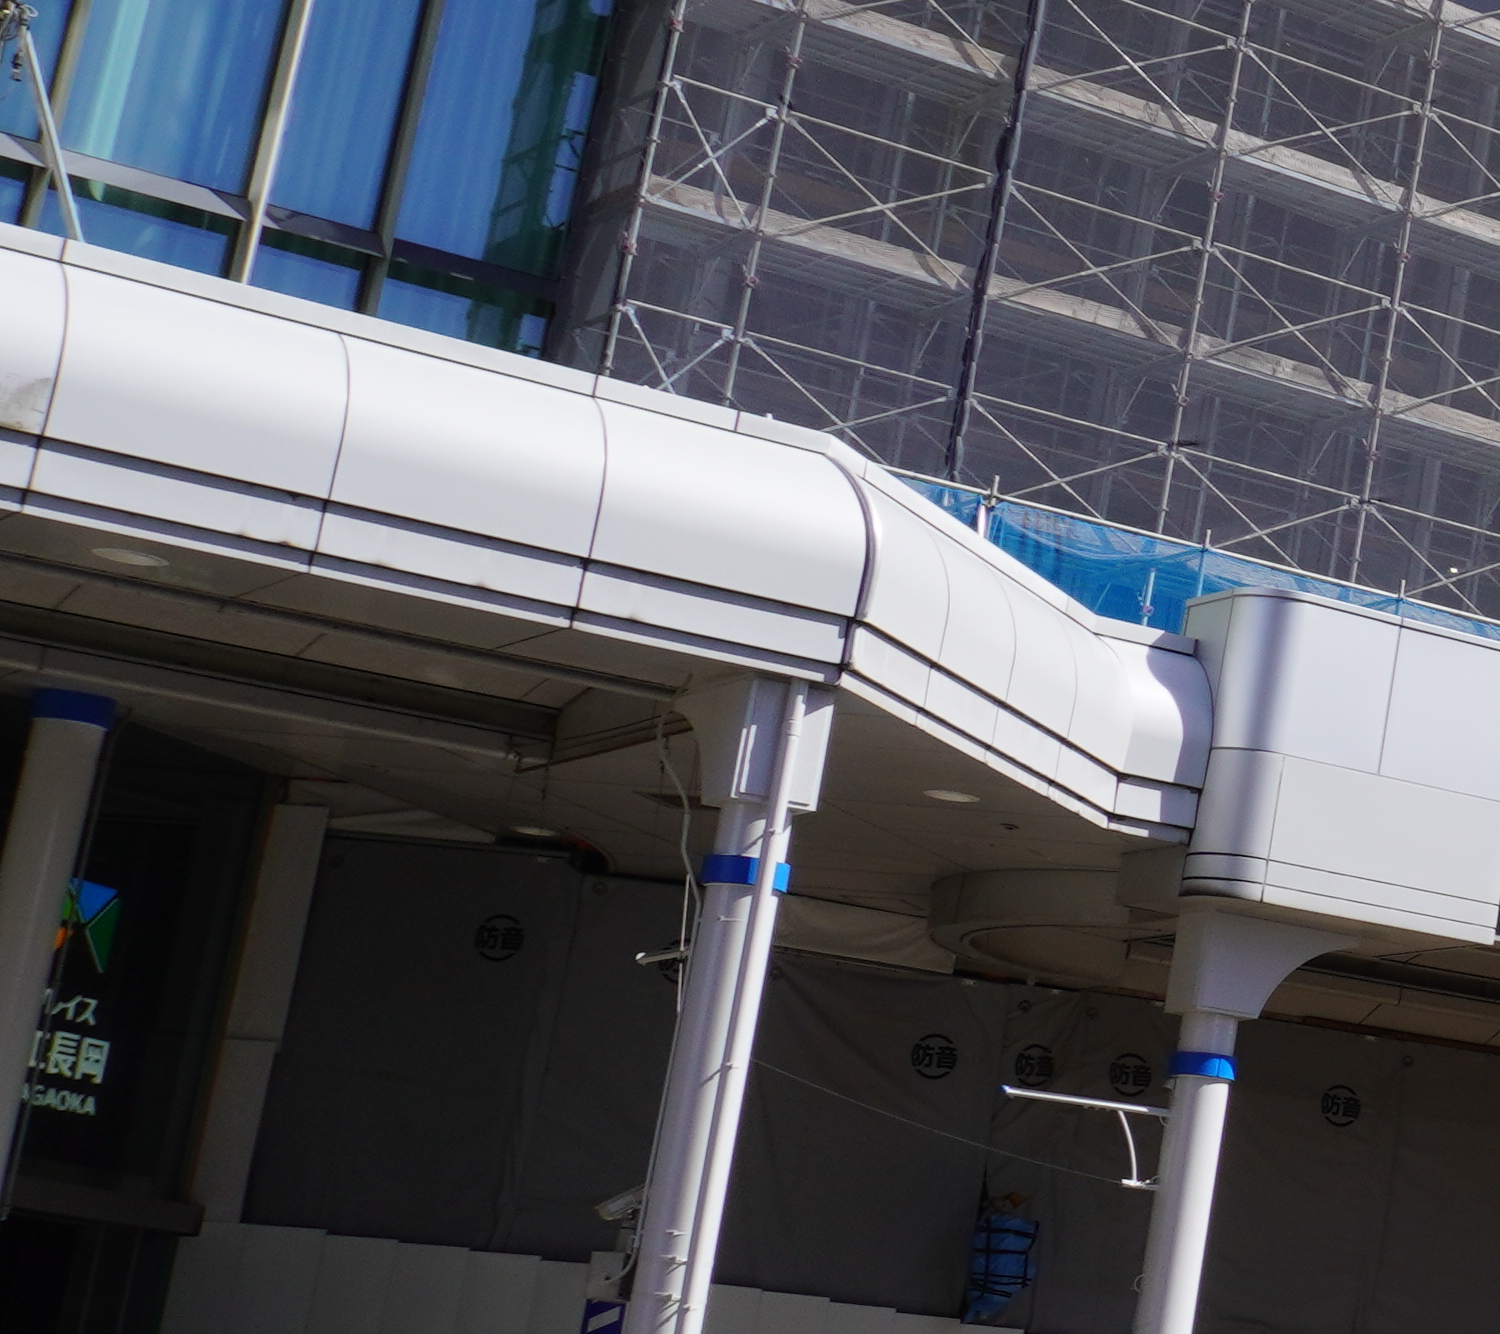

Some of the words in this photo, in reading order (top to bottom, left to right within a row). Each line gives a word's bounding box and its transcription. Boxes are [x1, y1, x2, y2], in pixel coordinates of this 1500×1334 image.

[475, 925, 525, 954] 防音
[911, 1042, 958, 1070] 防音
[1014, 1053, 1055, 1079] 防音
[1109, 1061, 1152, 1087] 防音
[1321, 1093, 1362, 1118] 防音
